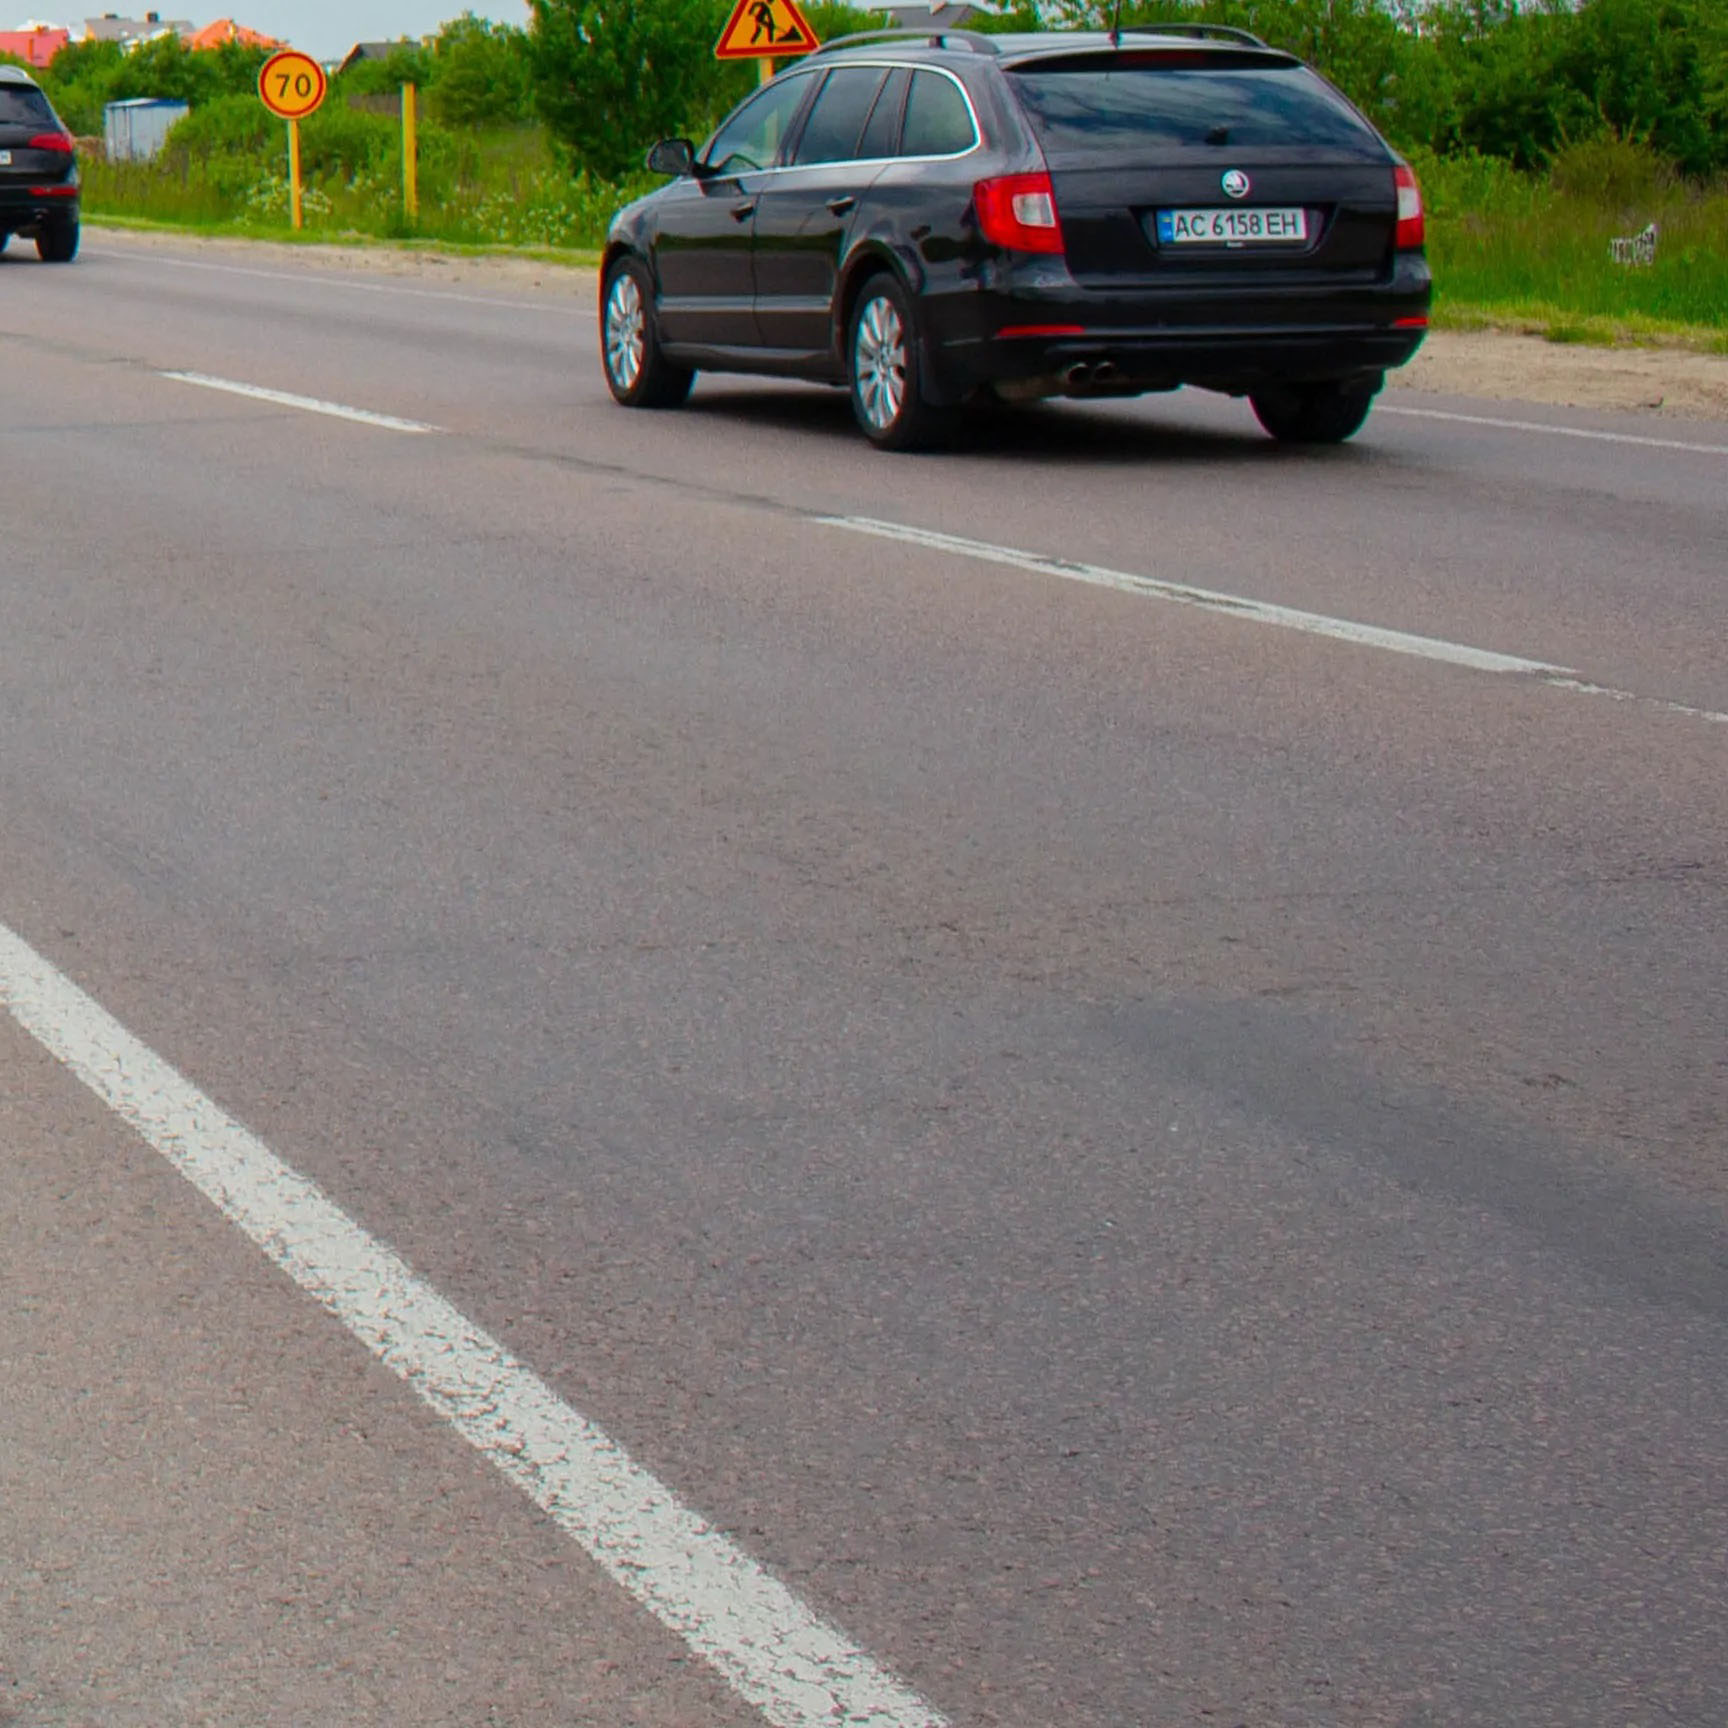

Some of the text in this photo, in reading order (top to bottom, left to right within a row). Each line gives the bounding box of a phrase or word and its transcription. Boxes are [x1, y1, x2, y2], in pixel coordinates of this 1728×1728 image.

[276, 74, 311, 98] 70
[1175, 213, 1298, 237] AC 6158 EH
